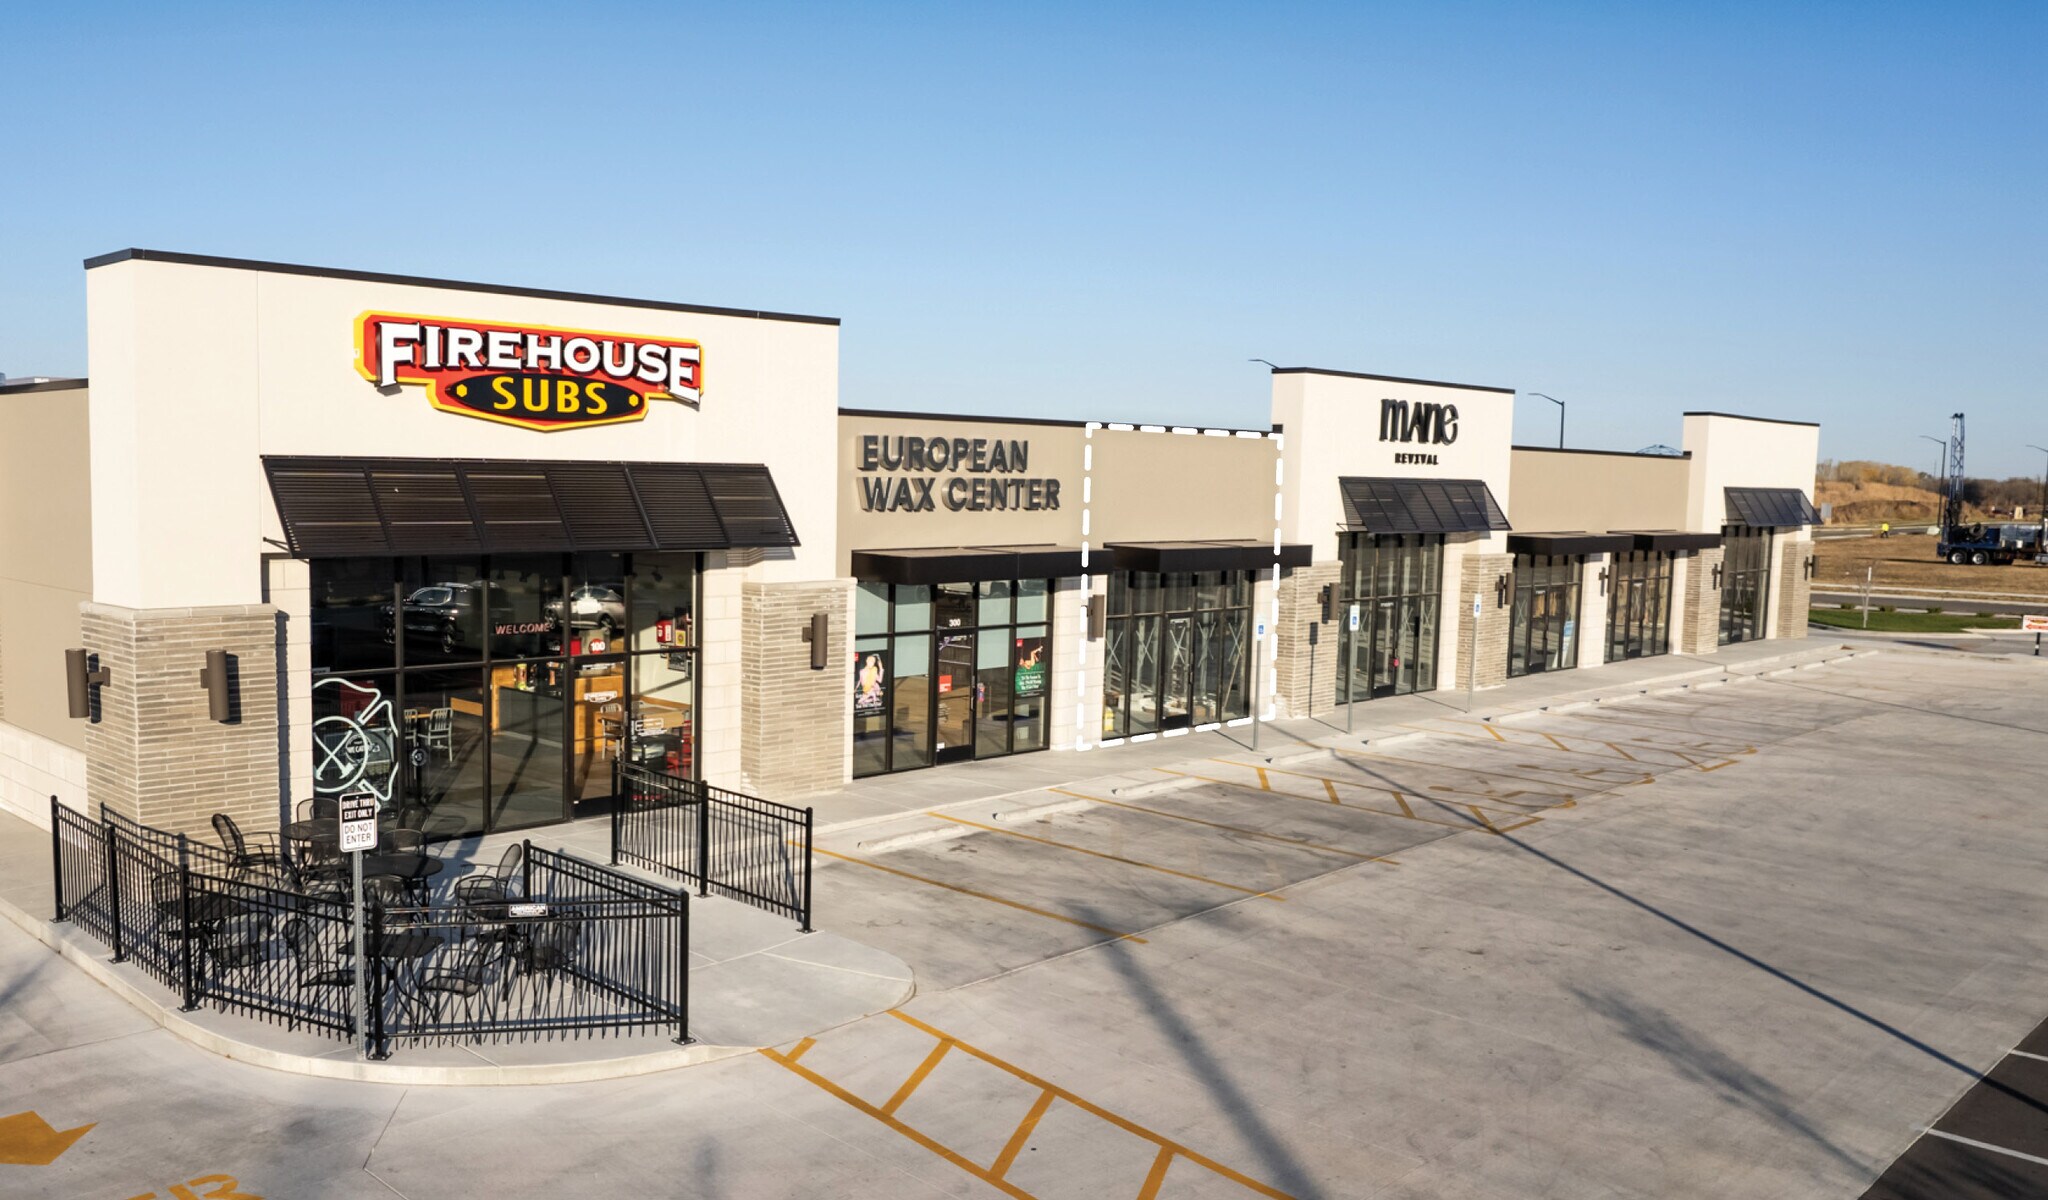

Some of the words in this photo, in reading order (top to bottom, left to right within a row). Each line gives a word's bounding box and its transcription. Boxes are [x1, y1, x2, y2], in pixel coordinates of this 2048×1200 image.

[377, 321, 700, 403] FIREHOUSE
[491, 376, 608, 416] SUBS
[856, 435, 1029, 472] EUROPEAN
[1394, 453, 1439, 466] REVIVAL
[856, 476, 936, 512] WAX
[941, 477, 1061, 512] CENTER
[495, 622, 551, 636] WELCOME
[949, 618, 962, 628] 300
[342, 799, 359, 810] DRIVE
[360, 797, 375, 808] THRU
[344, 810, 357, 820] EXIT
[357, 808, 373, 818] ONLY
[344, 824, 355, 835] DO
[357, 822, 373, 833] NOT
[346, 832, 372, 845] ENTER
